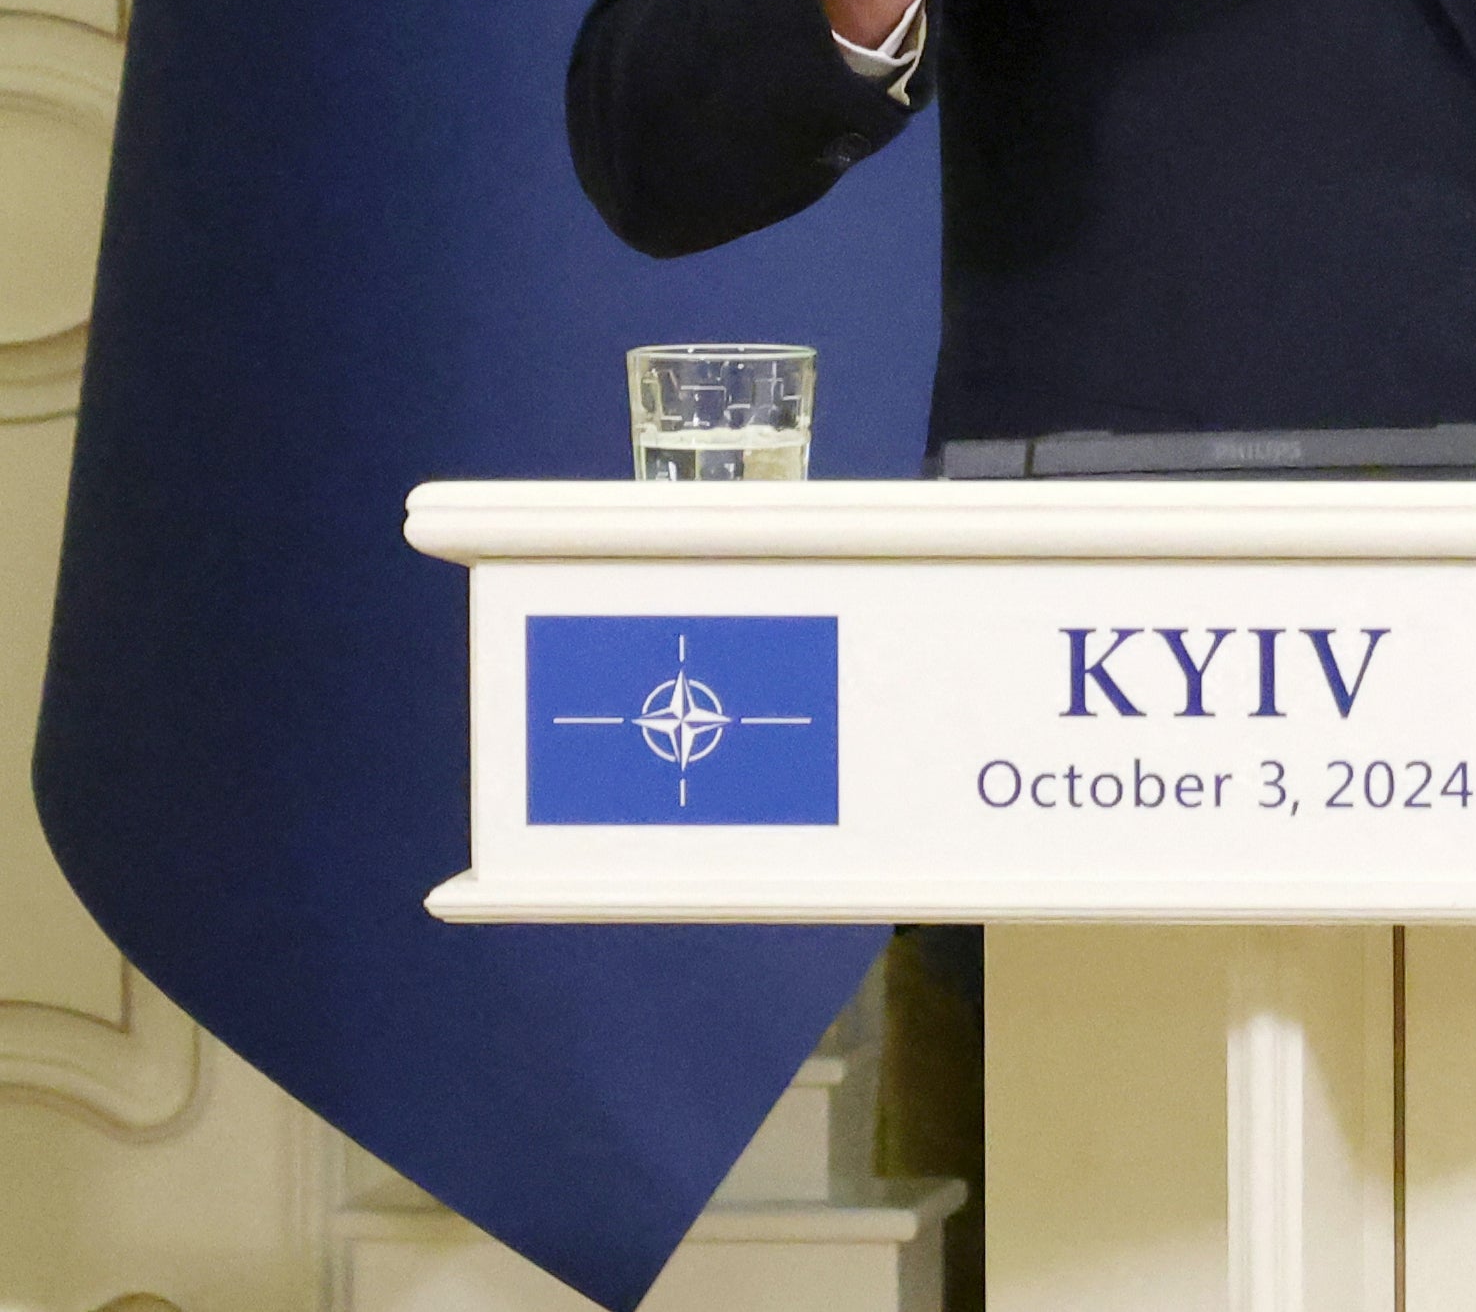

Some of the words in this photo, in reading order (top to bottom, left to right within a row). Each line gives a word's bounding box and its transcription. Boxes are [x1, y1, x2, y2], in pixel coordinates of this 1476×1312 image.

[1059, 627, 1392, 719] KYIV
[978, 758, 1233, 809] October
[1259, 760, 1299, 817] 3,
[1326, 760, 1474, 809] 2024
